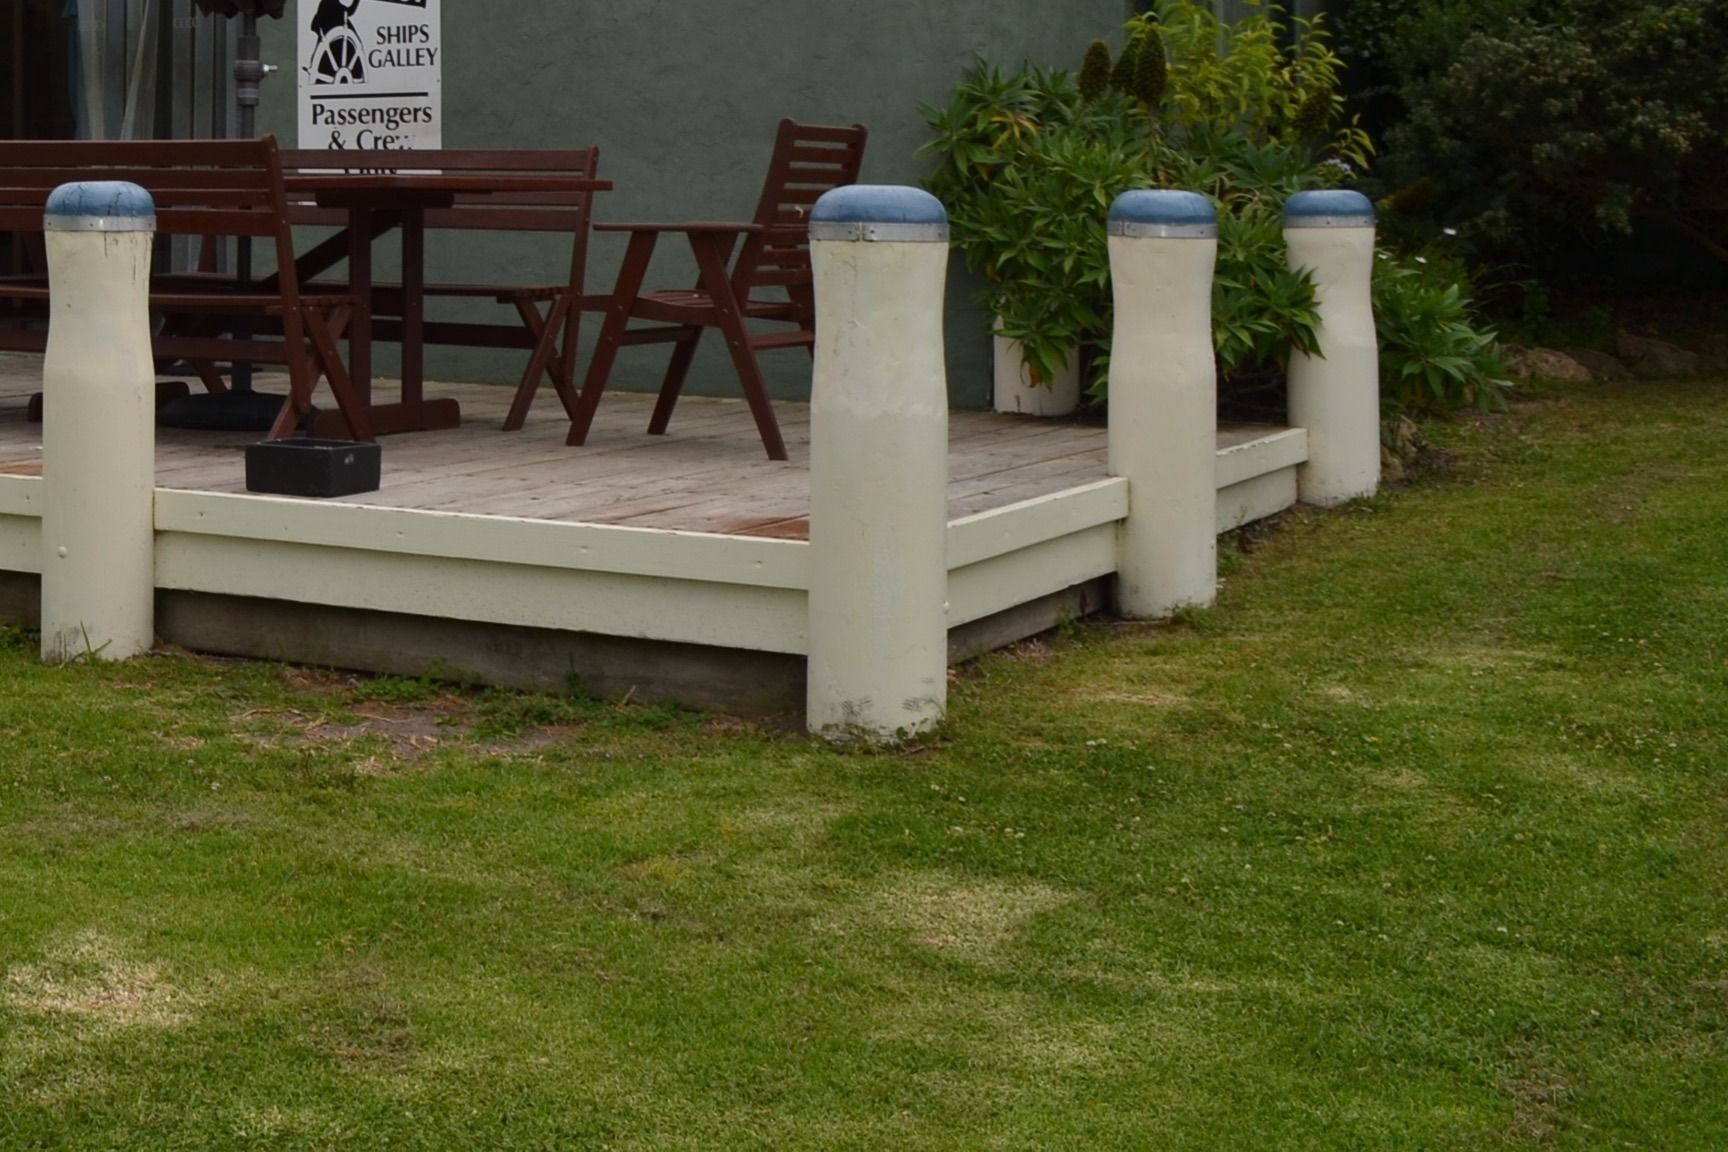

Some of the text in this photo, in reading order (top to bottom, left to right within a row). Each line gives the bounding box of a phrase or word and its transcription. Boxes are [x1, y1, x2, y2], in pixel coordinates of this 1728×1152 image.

[376, 24, 430, 45] SHIPS
[368, 47, 438, 68] GALLEY
[311, 104, 433, 131] Passengers
[328, 130, 347, 150] &
